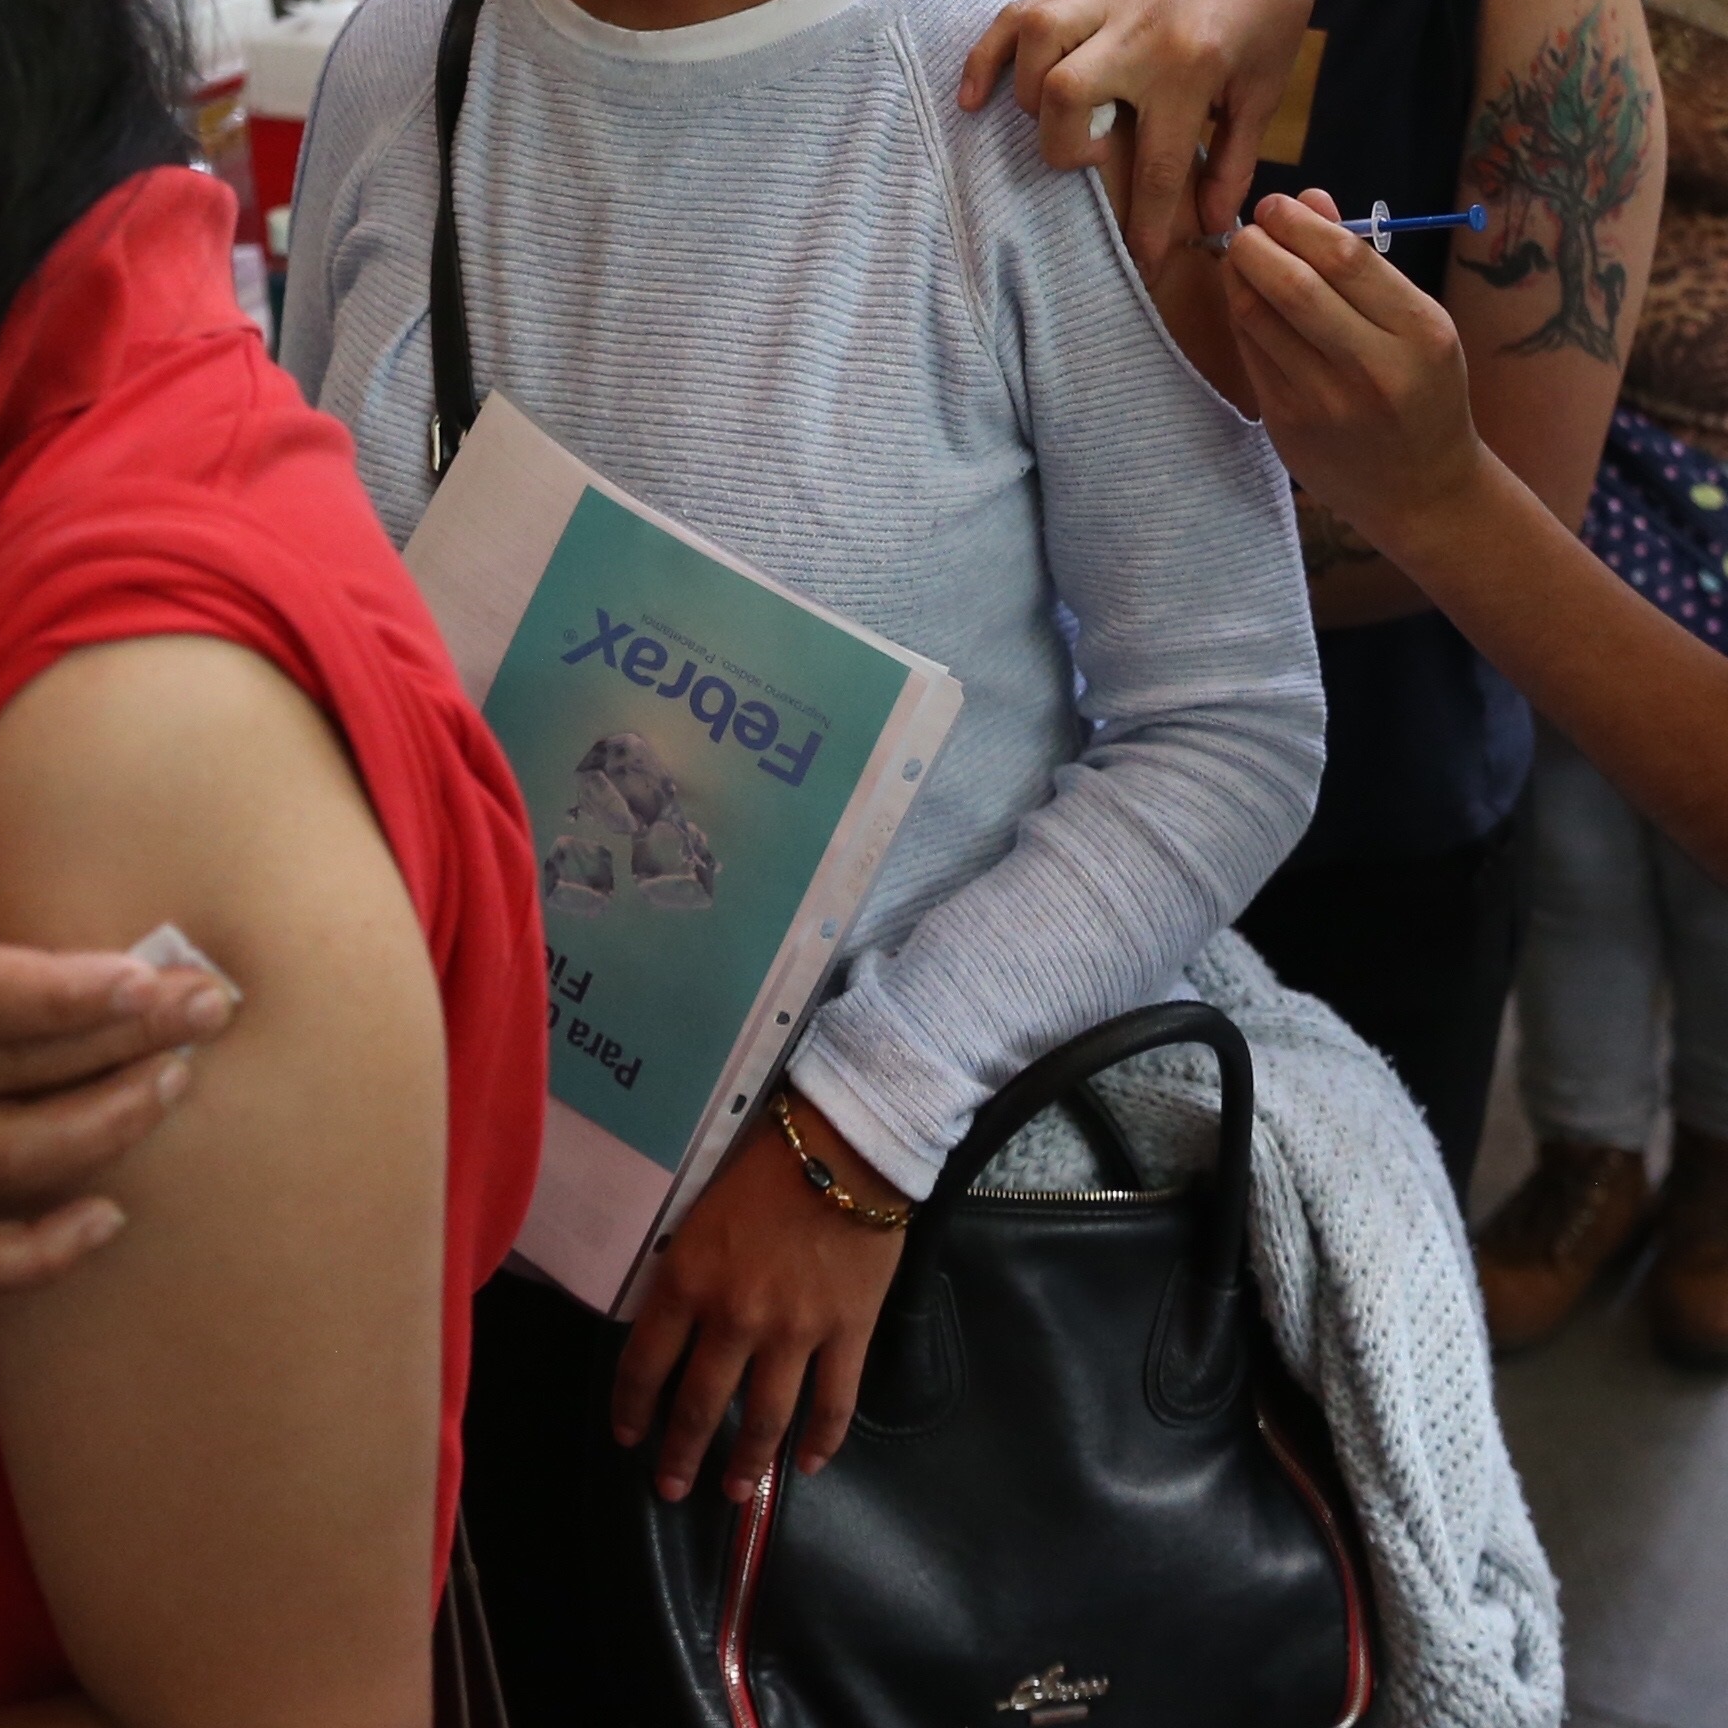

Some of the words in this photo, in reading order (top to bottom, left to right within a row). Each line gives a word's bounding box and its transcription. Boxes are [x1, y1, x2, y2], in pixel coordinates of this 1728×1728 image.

[641, 612, 718, 665] Paracetamol
[560, 607, 823, 788] Febrax
[566, 1017, 643, 1091] Para
